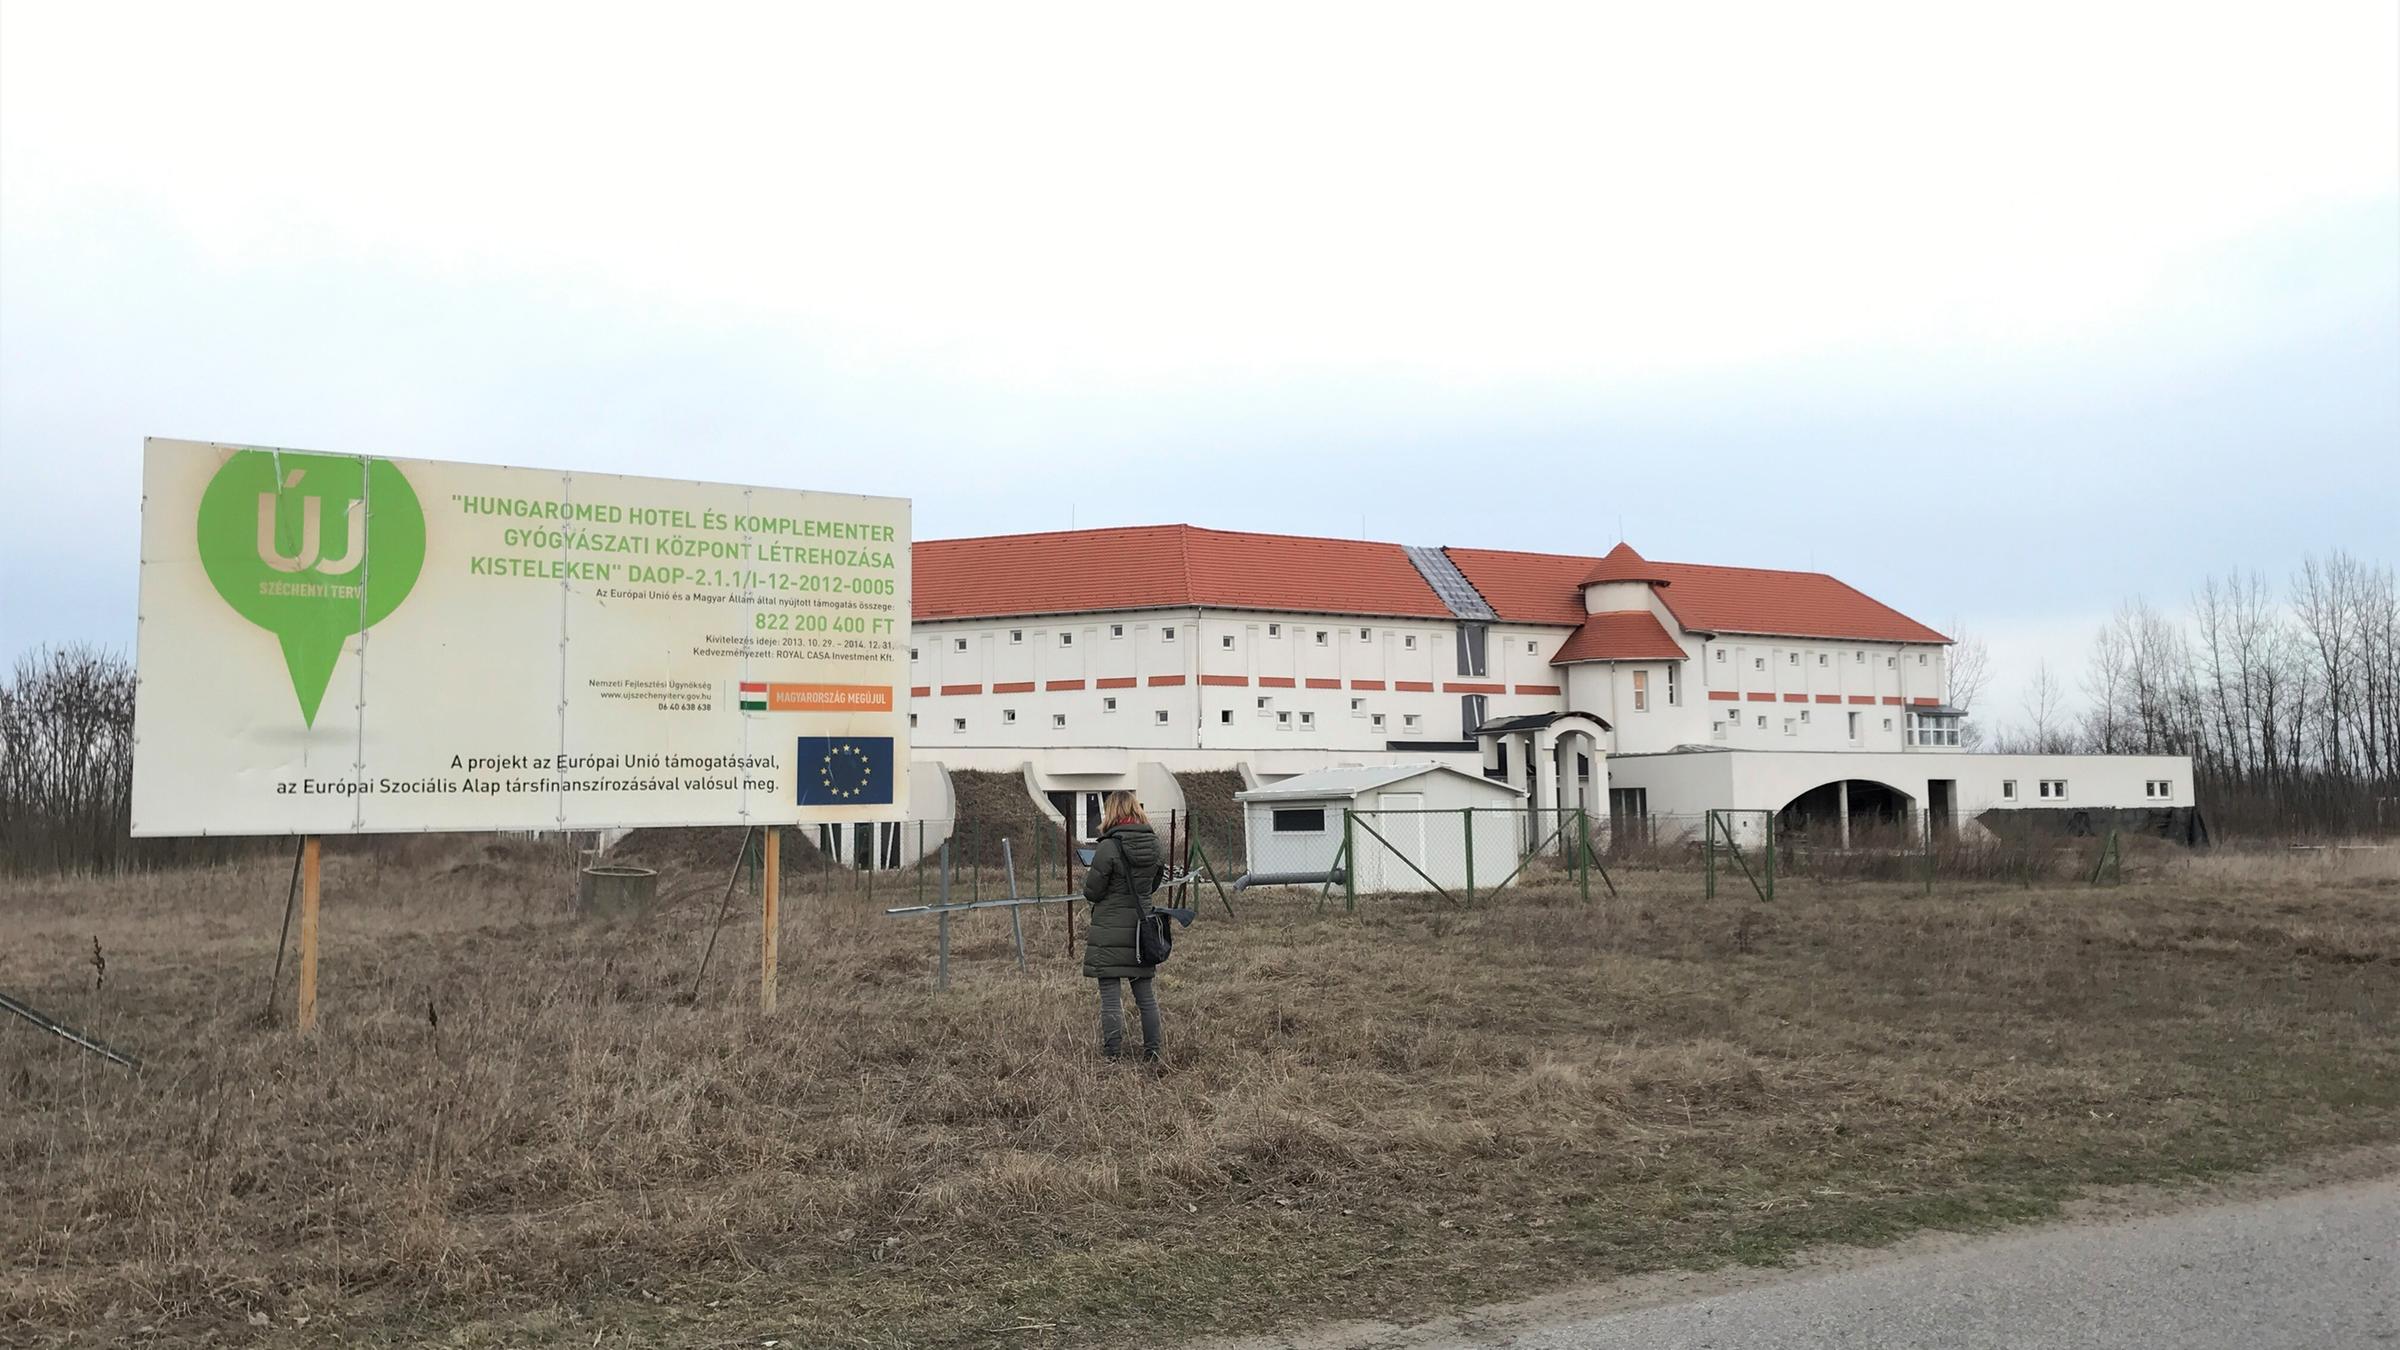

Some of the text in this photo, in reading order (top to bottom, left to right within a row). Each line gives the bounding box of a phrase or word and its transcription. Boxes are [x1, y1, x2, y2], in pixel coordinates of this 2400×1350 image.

[257, 468, 365, 575] ÚJ
[452, 494, 894, 542] "HUNGAROMED HOTEL ÉS KOMPLEMENTER
[504, 525, 895, 569] GYÓGYÁSZATI KÖZPONT LÉTREHOZÁSA
[471, 556, 621, 581] KISTELEKEN"
[259, 580, 363, 600] SZÉCHENYI TERV
[596, 588, 895, 612] Az Európai Unió és a Magyar Állam által nyújtott támogatás összege:
[755, 613, 895, 634] 822 200 400 FT
[705, 634, 754, 645] Kivitelezés
[756, 637, 780, 648] ideje:
[782, 638, 804, 647] 2013.
[808, 639, 820, 647] 10.
[822, 639, 834, 648] 29.
[844, 640, 866, 648] 2014.
[869, 641, 880, 649] 12.
[882, 641, 895, 650] 31.
[693, 647, 895, 662] Kedvezményezett: ROYAL CASA Investment Kft.
[589, 679, 711, 690] Nemzeti Fejlesztési Ügynökség
[600, 691, 711, 701] www.ujszechenyiterv.gov.hu
[776, 690, 886, 705] MAGYARORSZÁG MEGÚJUL
[658, 703, 711, 711] 06 40 638 638
[450, 754, 779, 772] A projekt az Európai Unió támogatásával,
[277, 776, 779, 797] az Európai Szociális Alap társfinanszírozásával valósul meg.
